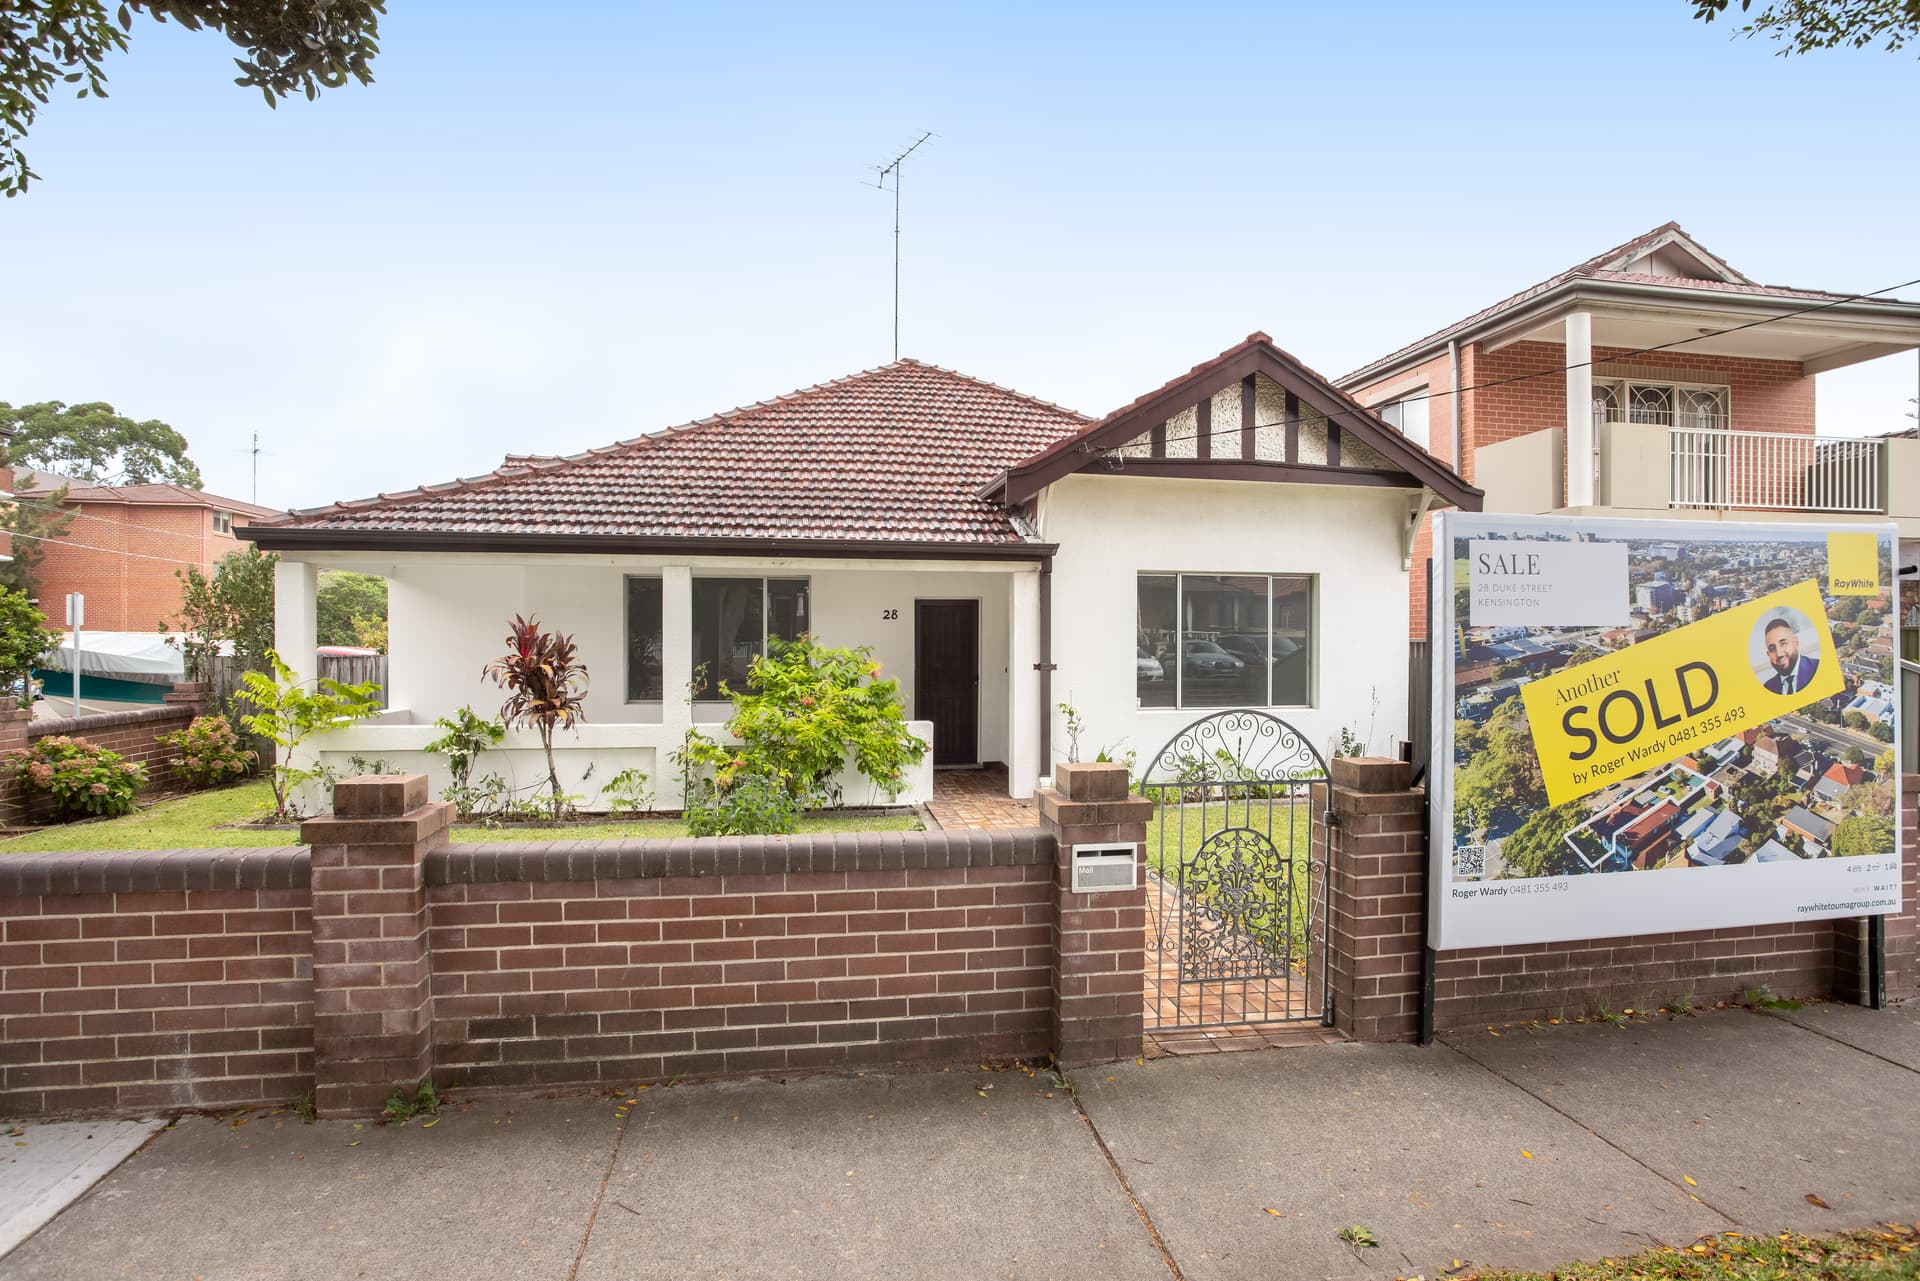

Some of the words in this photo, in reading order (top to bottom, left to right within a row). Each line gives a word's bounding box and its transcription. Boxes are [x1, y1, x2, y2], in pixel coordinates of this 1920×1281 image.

[1479, 553, 1540, 575] SALE
[1478, 584, 1488, 592] 28
[1492, 584, 1517, 592] DUKE
[1521, 584, 1552, 593] STREET
[1833, 579, 1875, 589] RayWhite
[1478, 598, 1540, 607] KENSINGTON
[882, 609, 898, 620] 28
[1555, 670, 1621, 706] Another
[1562, 661, 1719, 761] SOLD
[1573, 772, 1589, 785] by
[1591, 757, 1626, 778] Roger
[1627, 739, 1667, 764] Wardy
[1668, 726, 1698, 747] 0481
[1700, 718, 1722, 735] 355
[1724, 706, 1746, 724] 493
[1452, 888, 1478, 899] Roger
[1479, 886, 1508, 897] Wardy
[1510, 884, 1531, 895] 0481
[1534, 883, 1550, 893] 355
[1552, 881, 1569, 891] 493
[1797, 899, 1897, 913] raywhitetoumagroup.com.au
